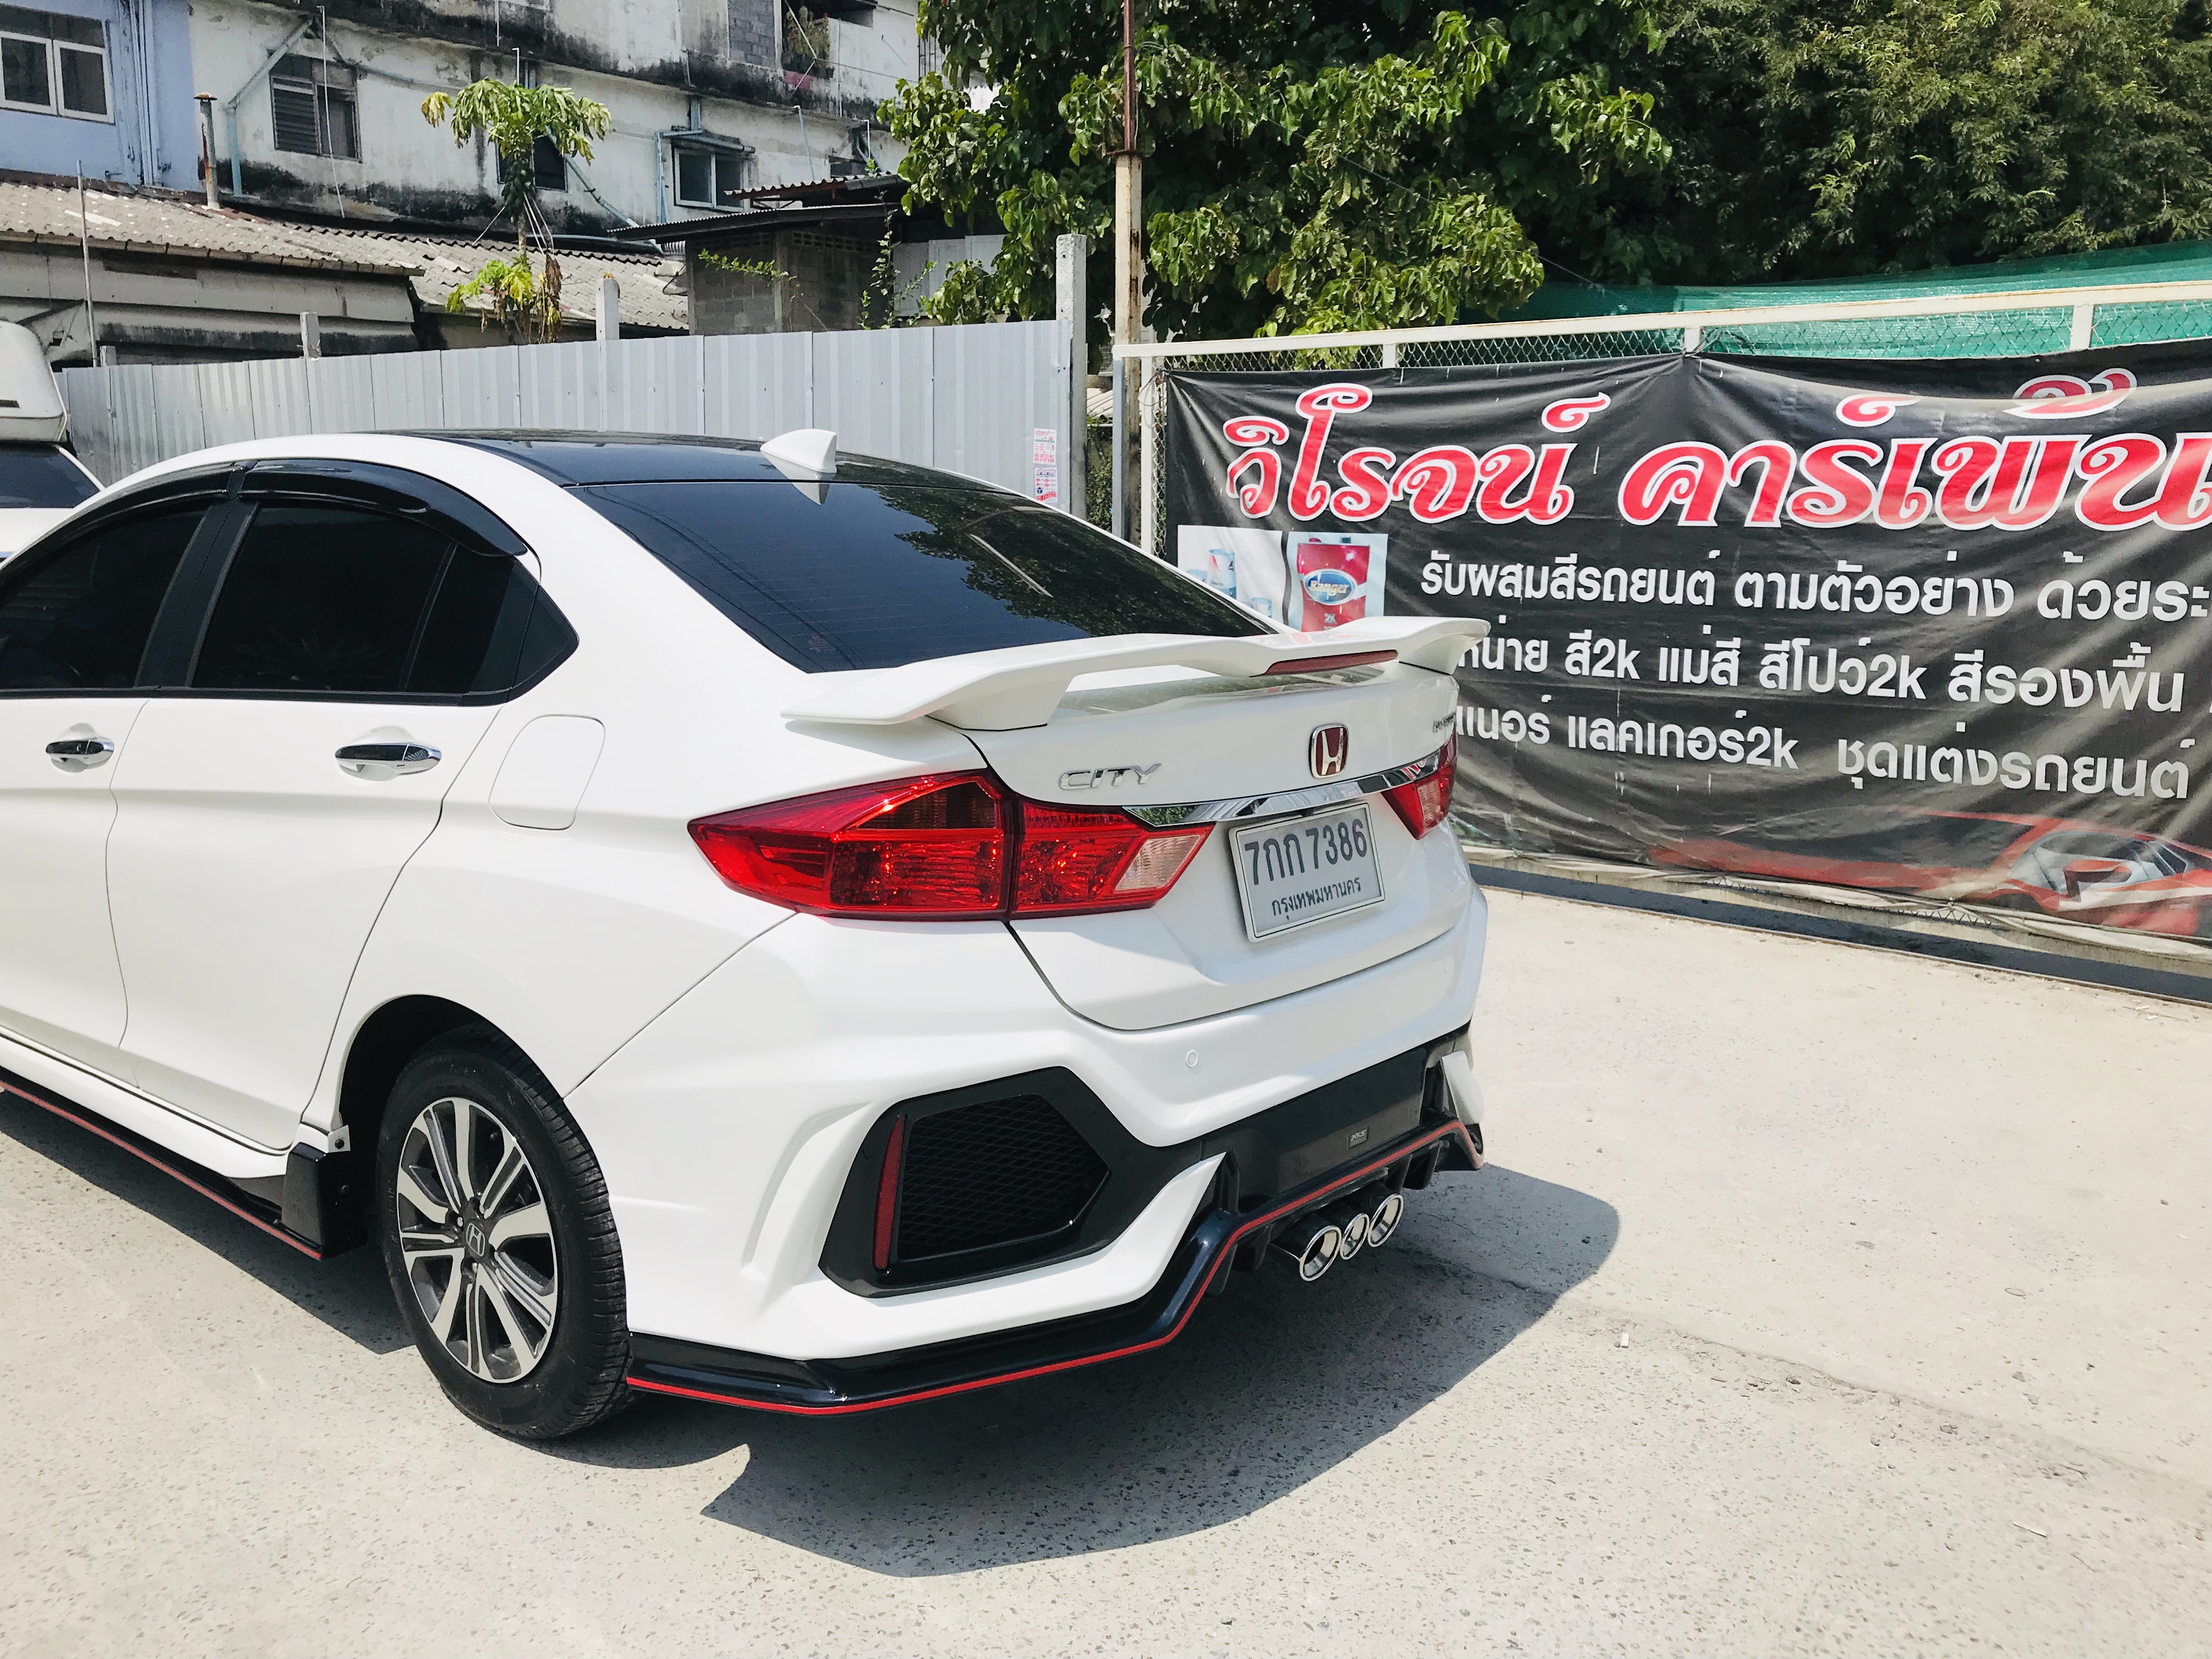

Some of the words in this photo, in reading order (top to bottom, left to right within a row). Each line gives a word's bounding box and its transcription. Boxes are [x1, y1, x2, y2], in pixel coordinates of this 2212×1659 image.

[1223, 382, 1611, 524] วิโรจน์
[1421, 550, 1720, 606] รับผสมสีรถยนต์
[1735, 550, 2015, 617] ตามตัวอย่าง
[2037, 551, 2210, 621] ด้วยระ
[1565, 629, 1640, 680] สี2k
[1658, 624, 1741, 686] แม่สี
[1948, 642, 2184, 712] สีรองพื้น
[1058, 763, 1162, 791] CITY
[1568, 710, 1799, 769] แลคเกอร์2k
[1838, 721, 2196, 799] ชุดแต่งรถยนต์
[1244, 833, 1305, 885] 7กก
[1305, 818, 1367, 870] 7386
[1271, 877, 1362, 920] กรุงเทพมหานคร
